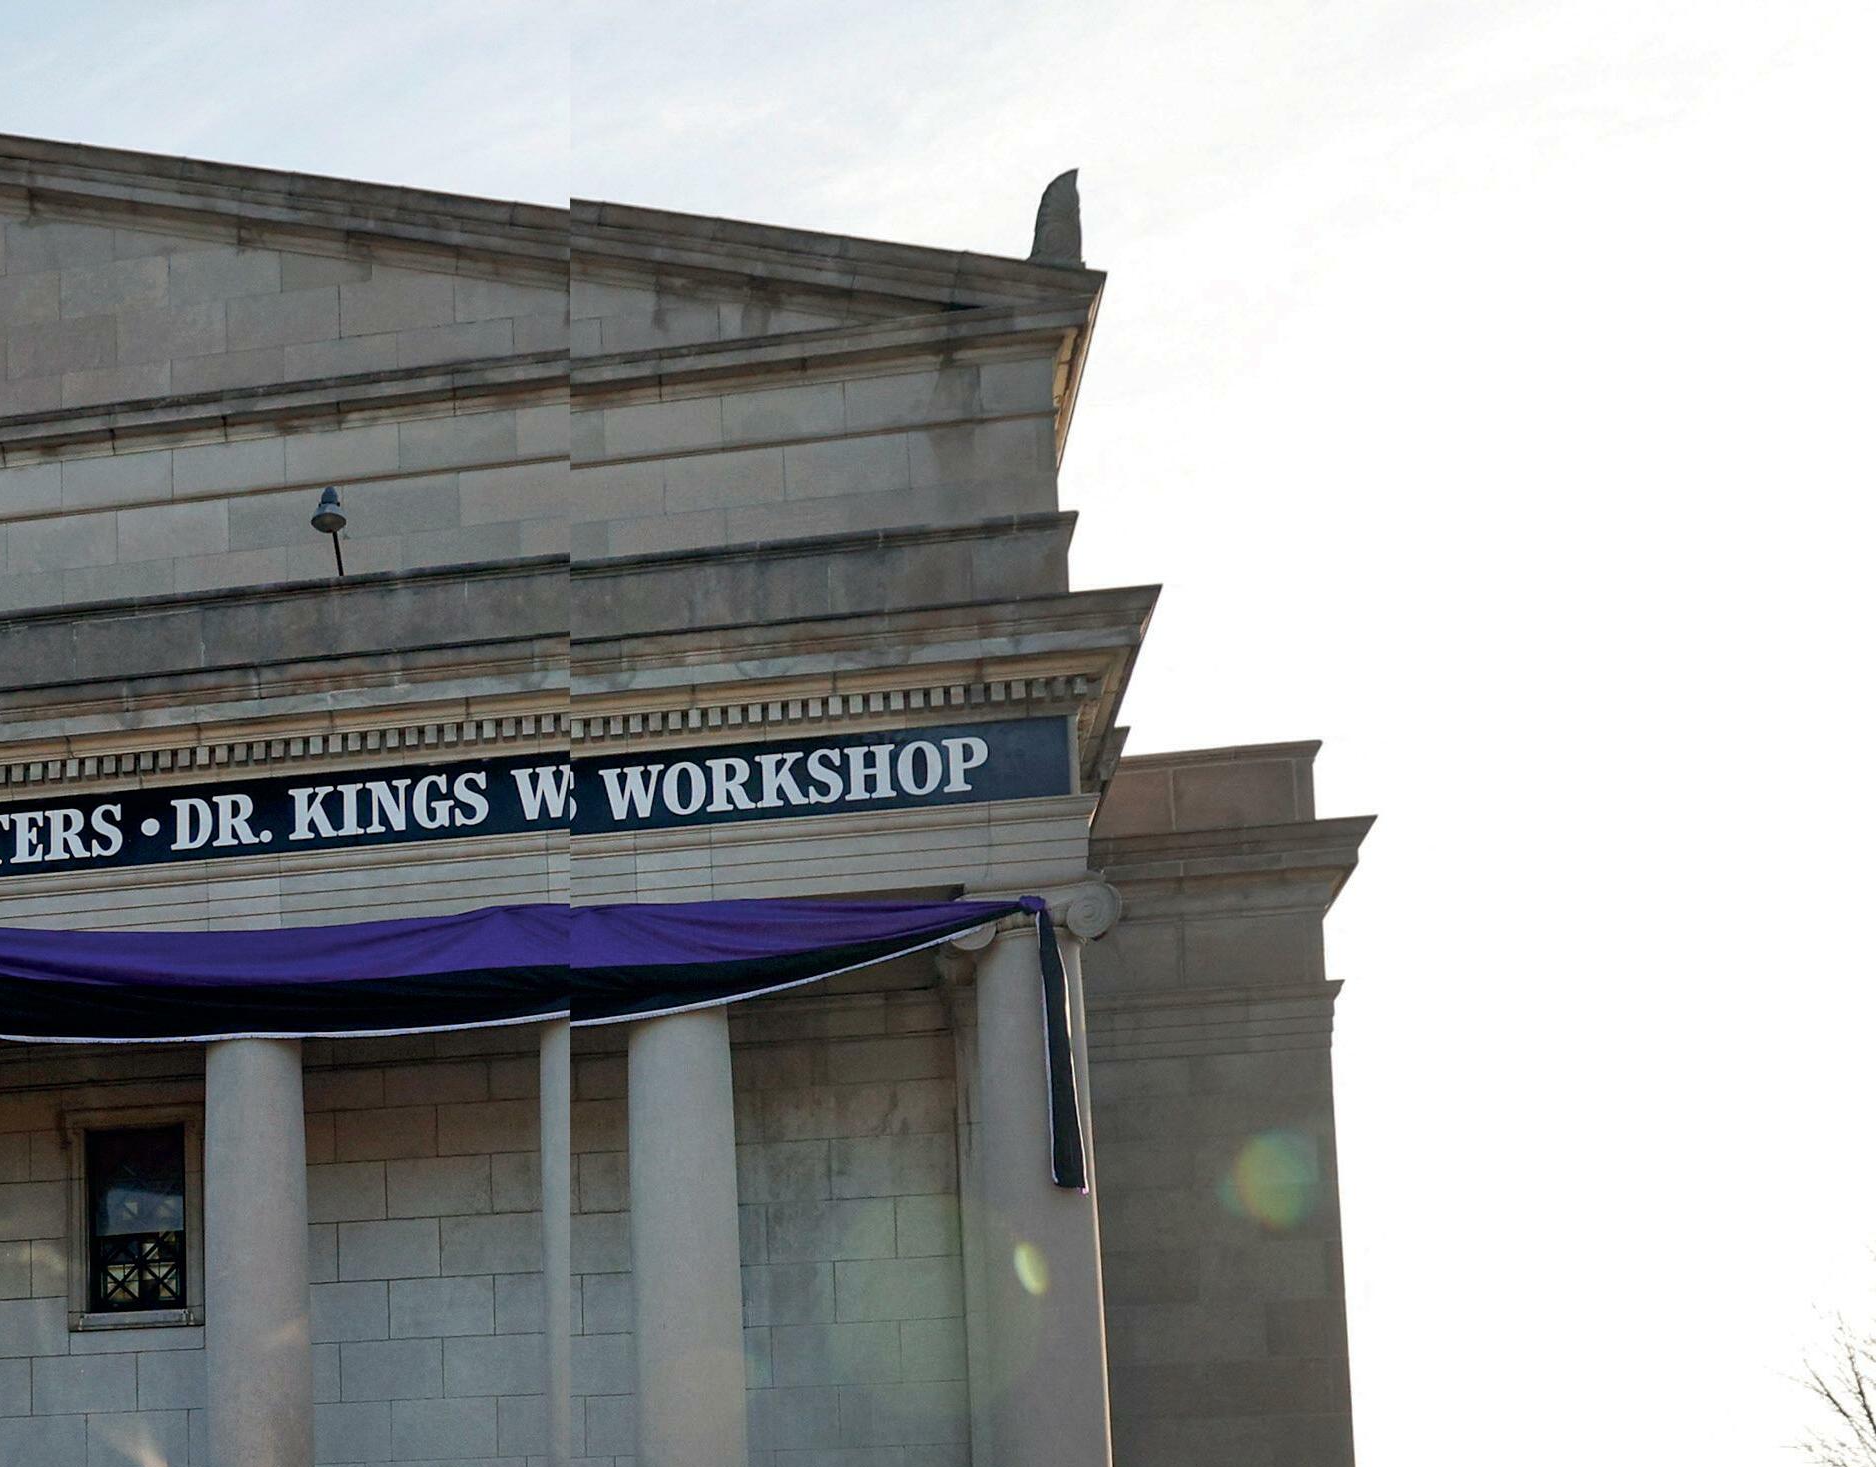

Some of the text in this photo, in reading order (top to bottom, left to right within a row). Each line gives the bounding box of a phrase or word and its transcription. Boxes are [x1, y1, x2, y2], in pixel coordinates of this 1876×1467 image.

[170, 795, 273, 851] DR.
[288, 771, 489, 839] KINGS
[598, 736, 989, 821] WORKSHOP
